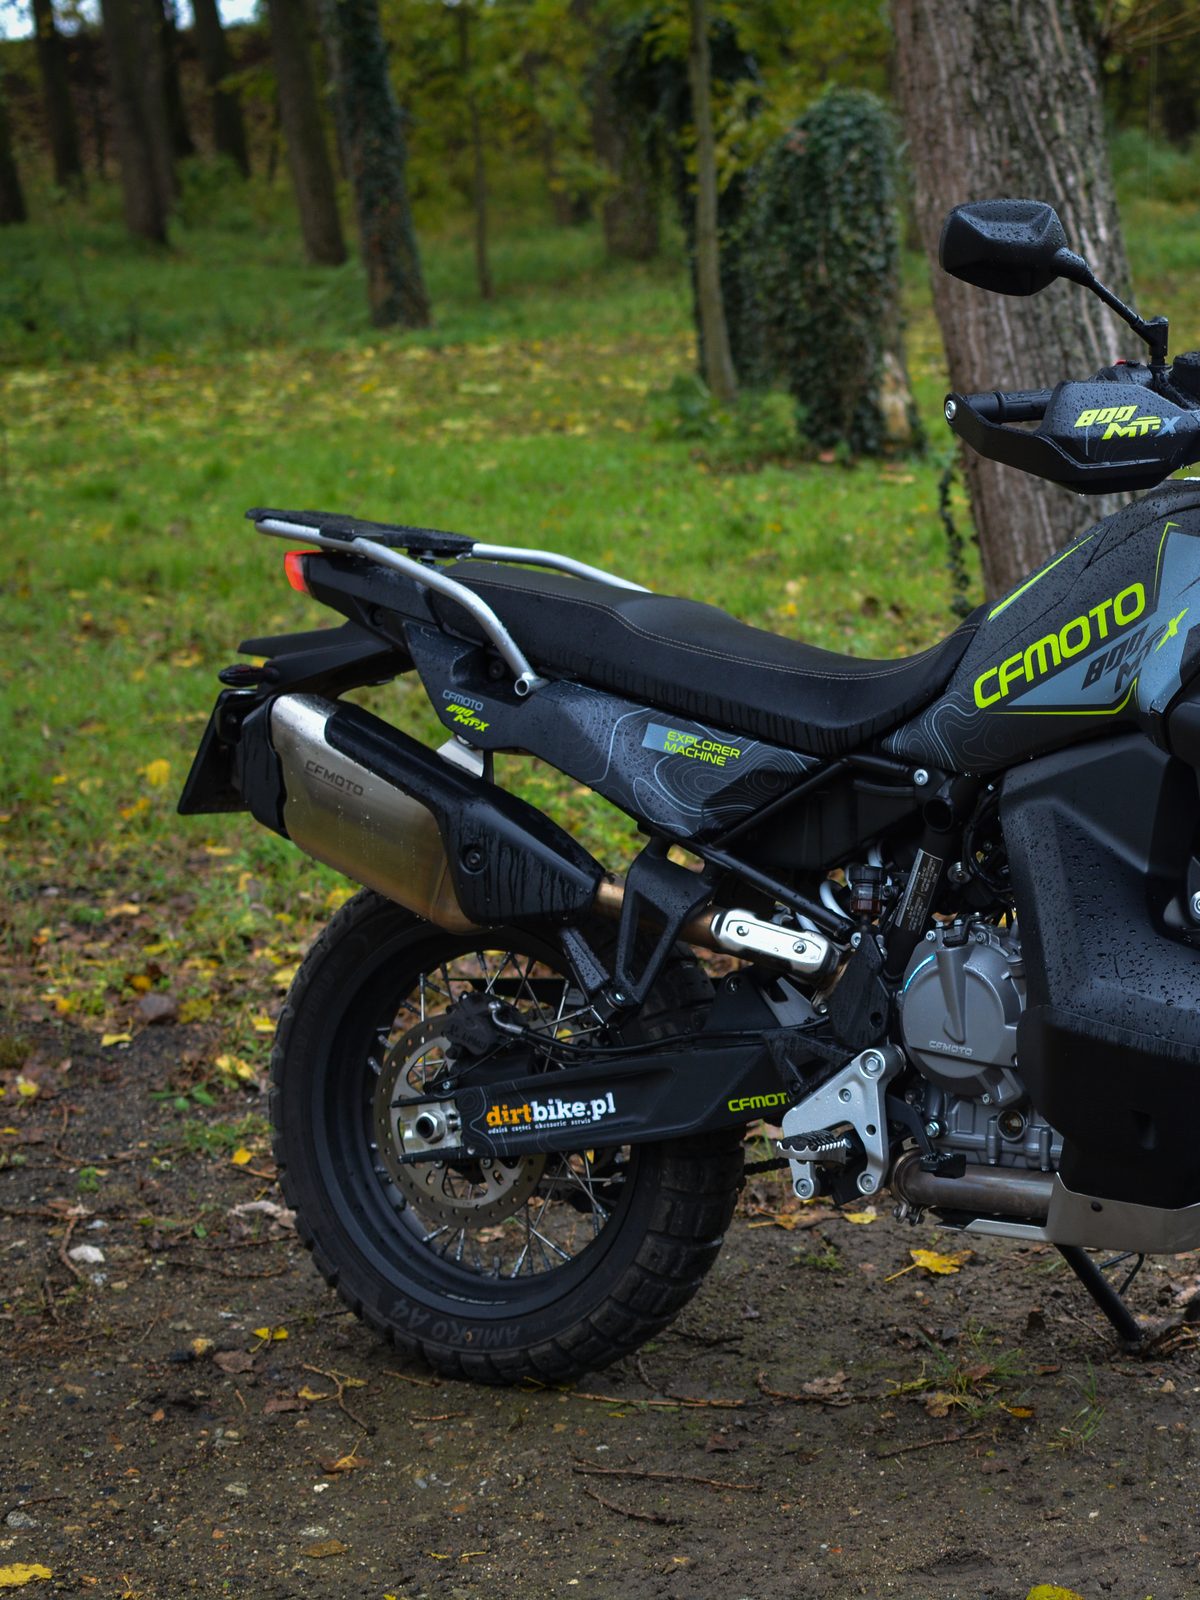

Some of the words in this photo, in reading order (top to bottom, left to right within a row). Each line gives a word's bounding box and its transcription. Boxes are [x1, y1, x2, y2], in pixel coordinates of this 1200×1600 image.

[1074, 405, 1138, 428] 800
[973, 582, 1146, 709] CFMOTO
[1081, 623, 1150, 690] 800
[442, 689, 484, 711] CFMOTO
[446, 704, 475, 717] 800
[663, 741, 727, 767] MACHINE
[667, 730, 741, 759] EXPLORER
[305, 759, 364, 796] CFMOTO
[928, 1040, 973, 1056] CFMOTO
[486, 1091, 616, 1127] dirtbike.pl
[727, 1092, 791, 1112] CFMOT
